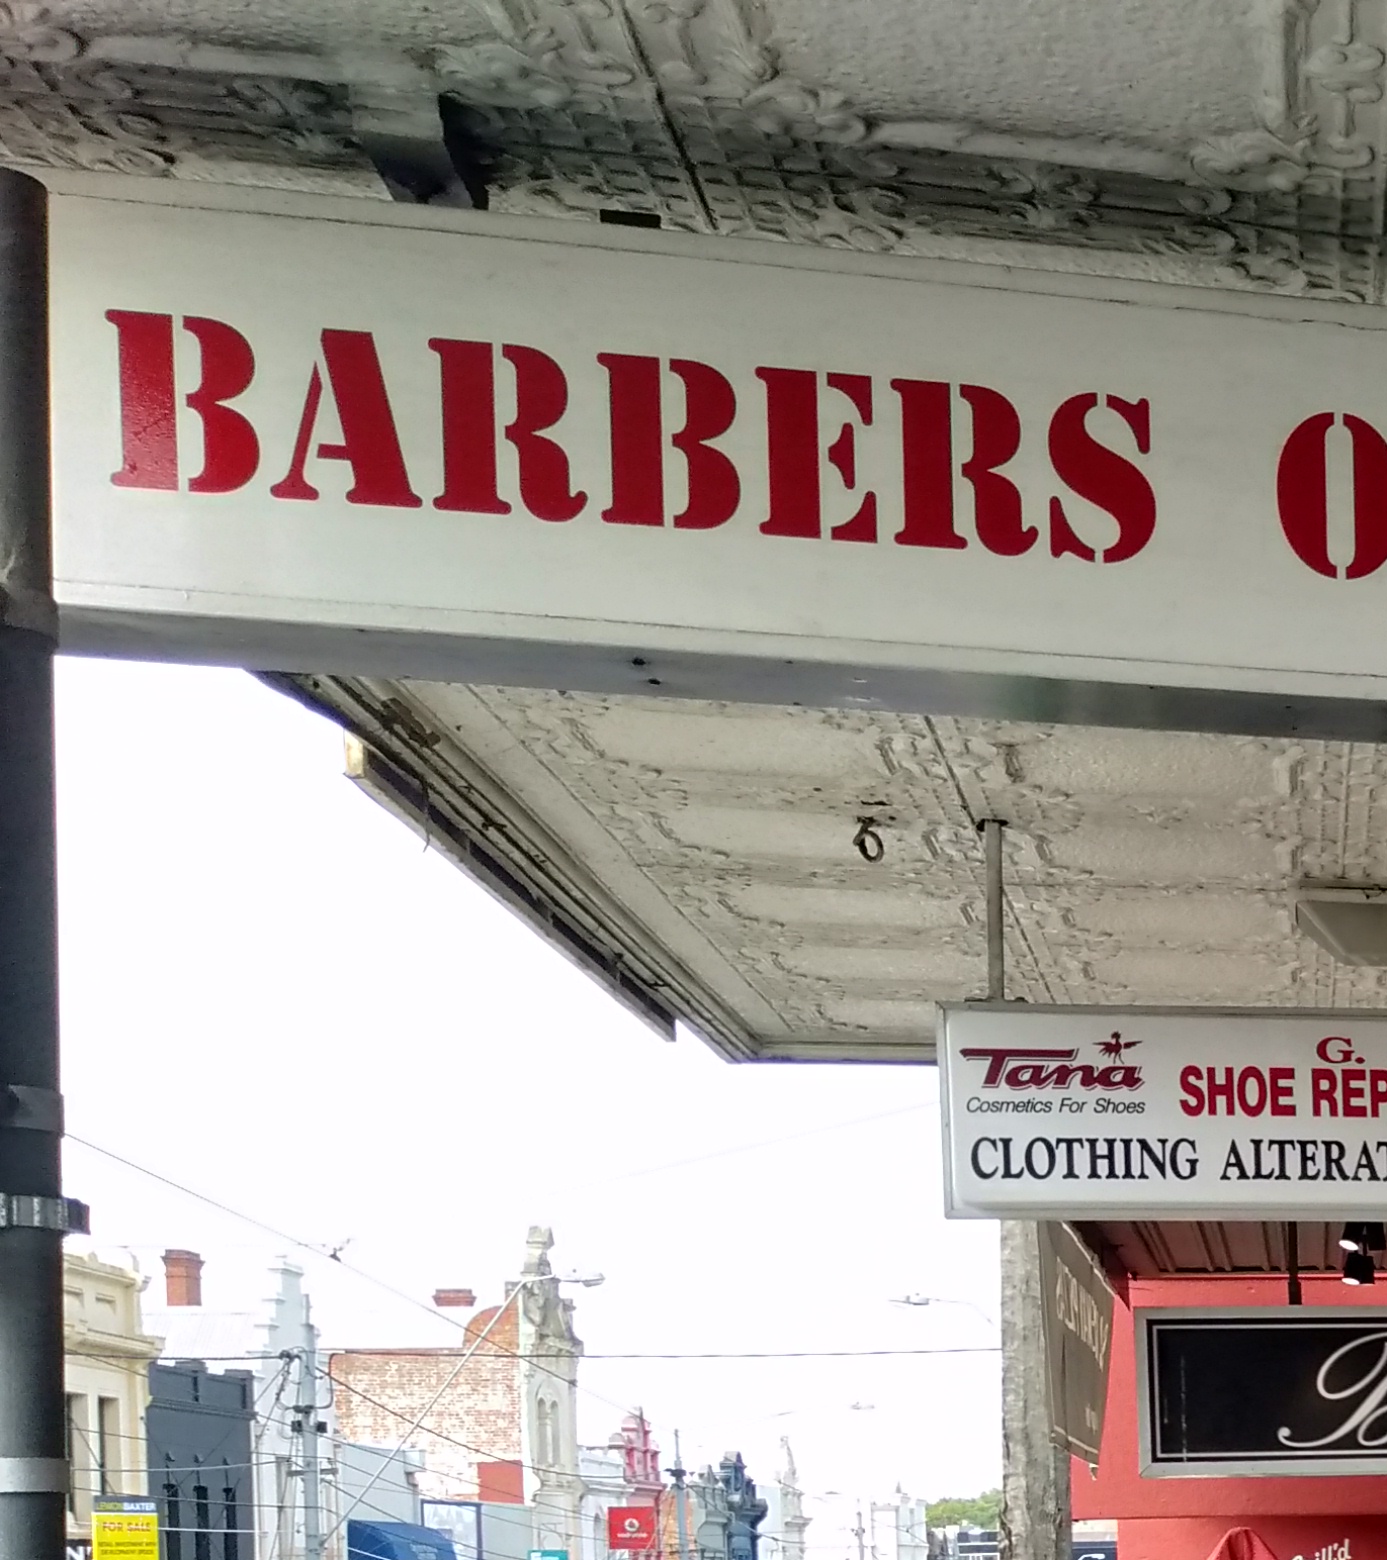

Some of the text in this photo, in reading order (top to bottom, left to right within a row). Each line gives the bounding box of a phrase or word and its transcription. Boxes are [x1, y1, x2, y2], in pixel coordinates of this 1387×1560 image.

[106, 308, 1158, 563] BARBERS
[959, 1047, 1146, 1093] Tana
[1316, 1036, 1366, 1065] G.
[965, 1096, 1146, 1116] Cosmetics For Shoes
[1179, 1064, 1297, 1118] SHOE
[970, 1136, 1199, 1181] CLOTHING
[102, 1521, 151, 1533] FOR SALE
